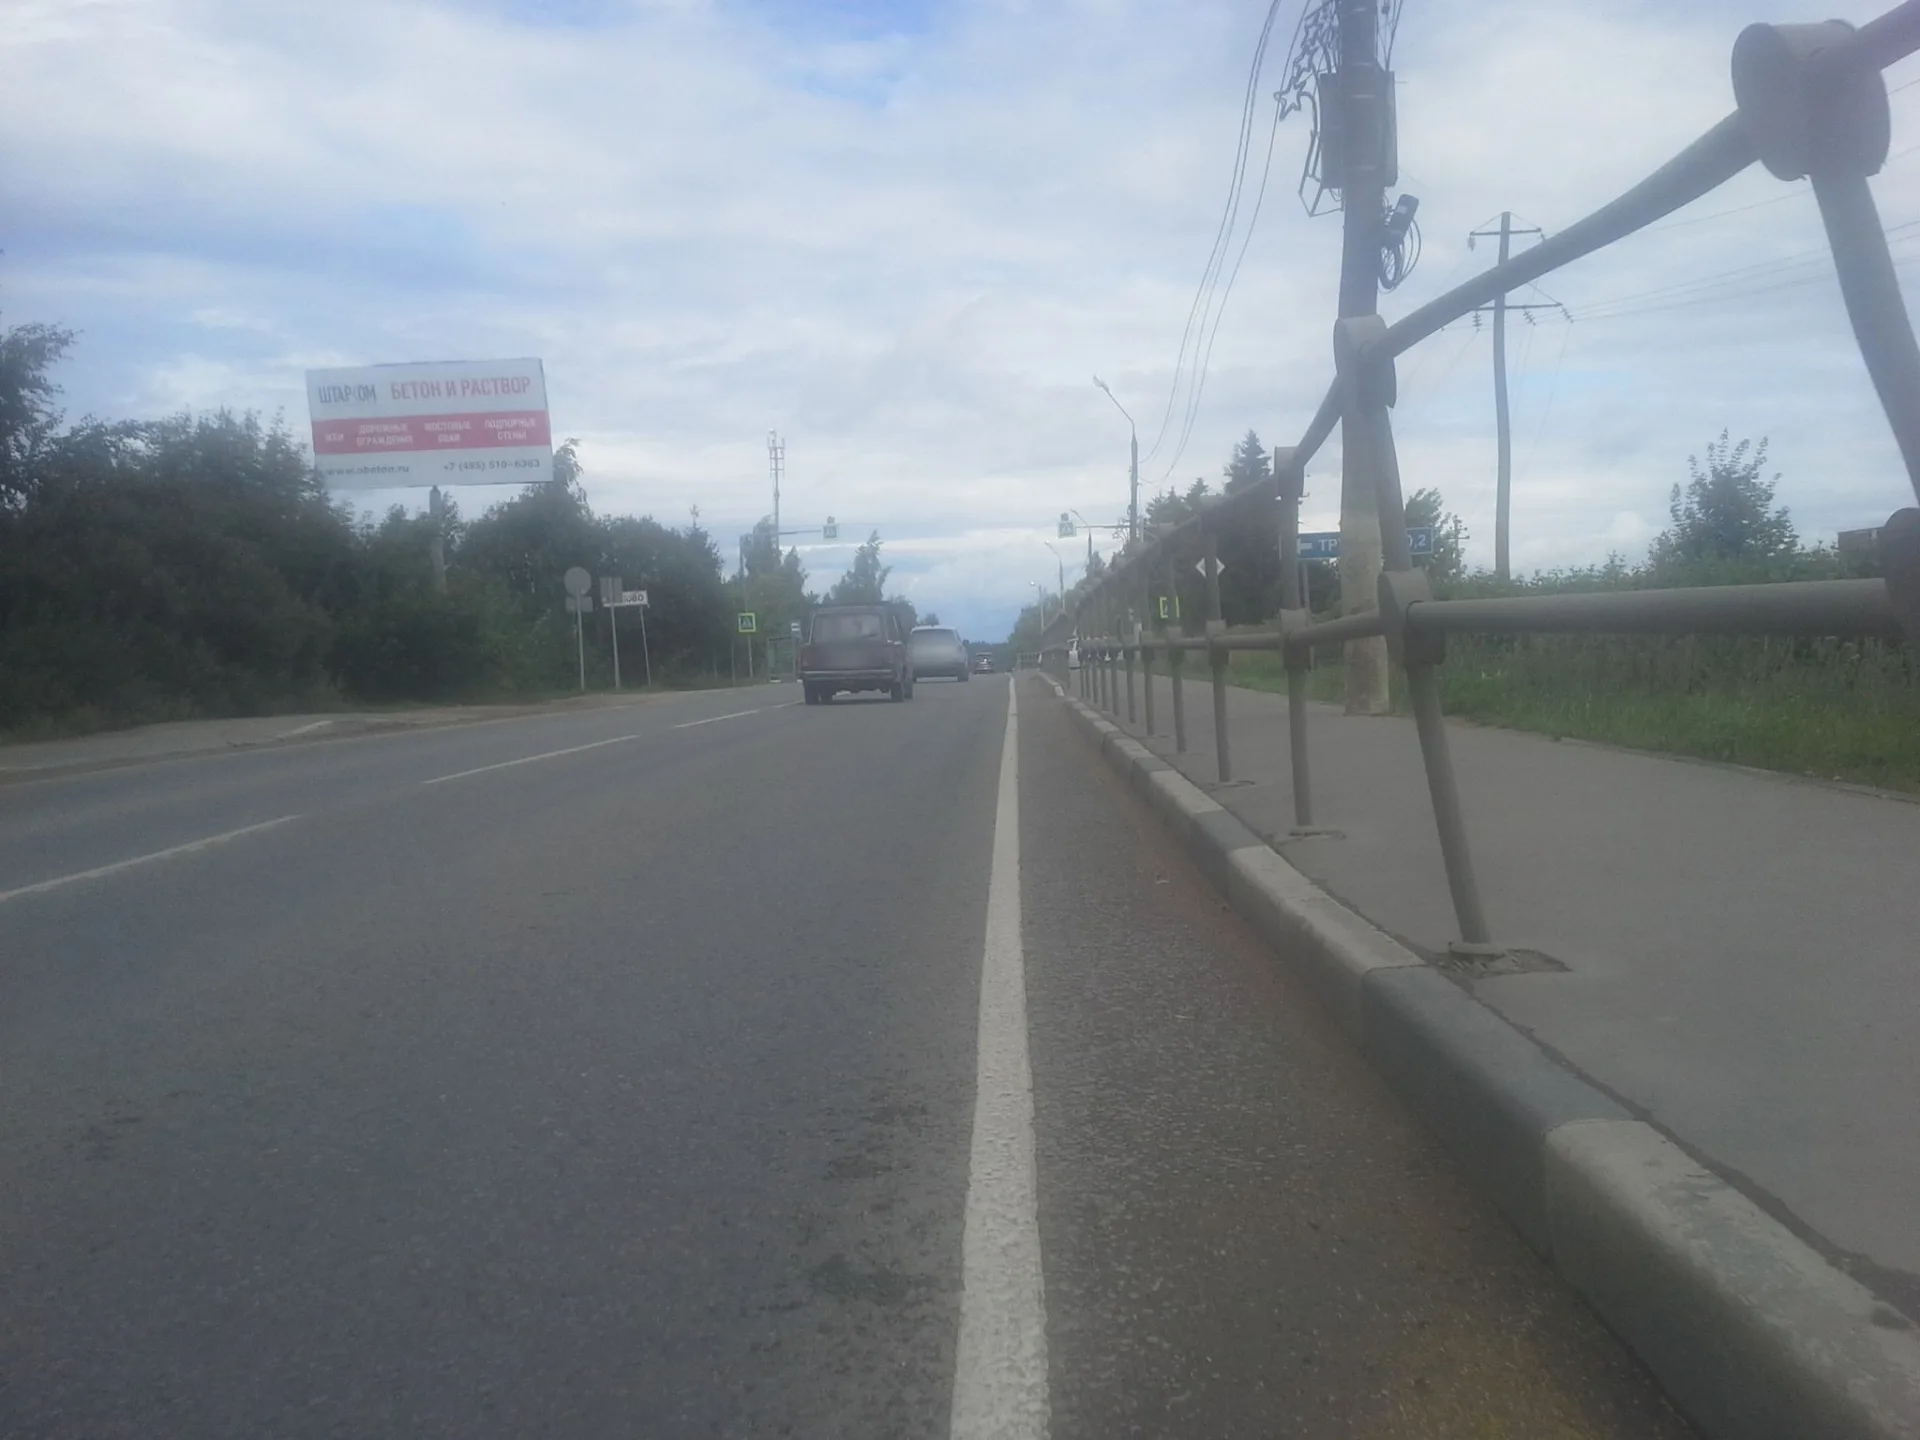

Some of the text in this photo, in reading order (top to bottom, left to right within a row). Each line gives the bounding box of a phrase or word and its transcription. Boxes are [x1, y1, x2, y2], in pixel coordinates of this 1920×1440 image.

[390, 376, 531, 400] БЕТОН И РАСТВОР
[497, 431, 527, 441] СТЕНЫ
